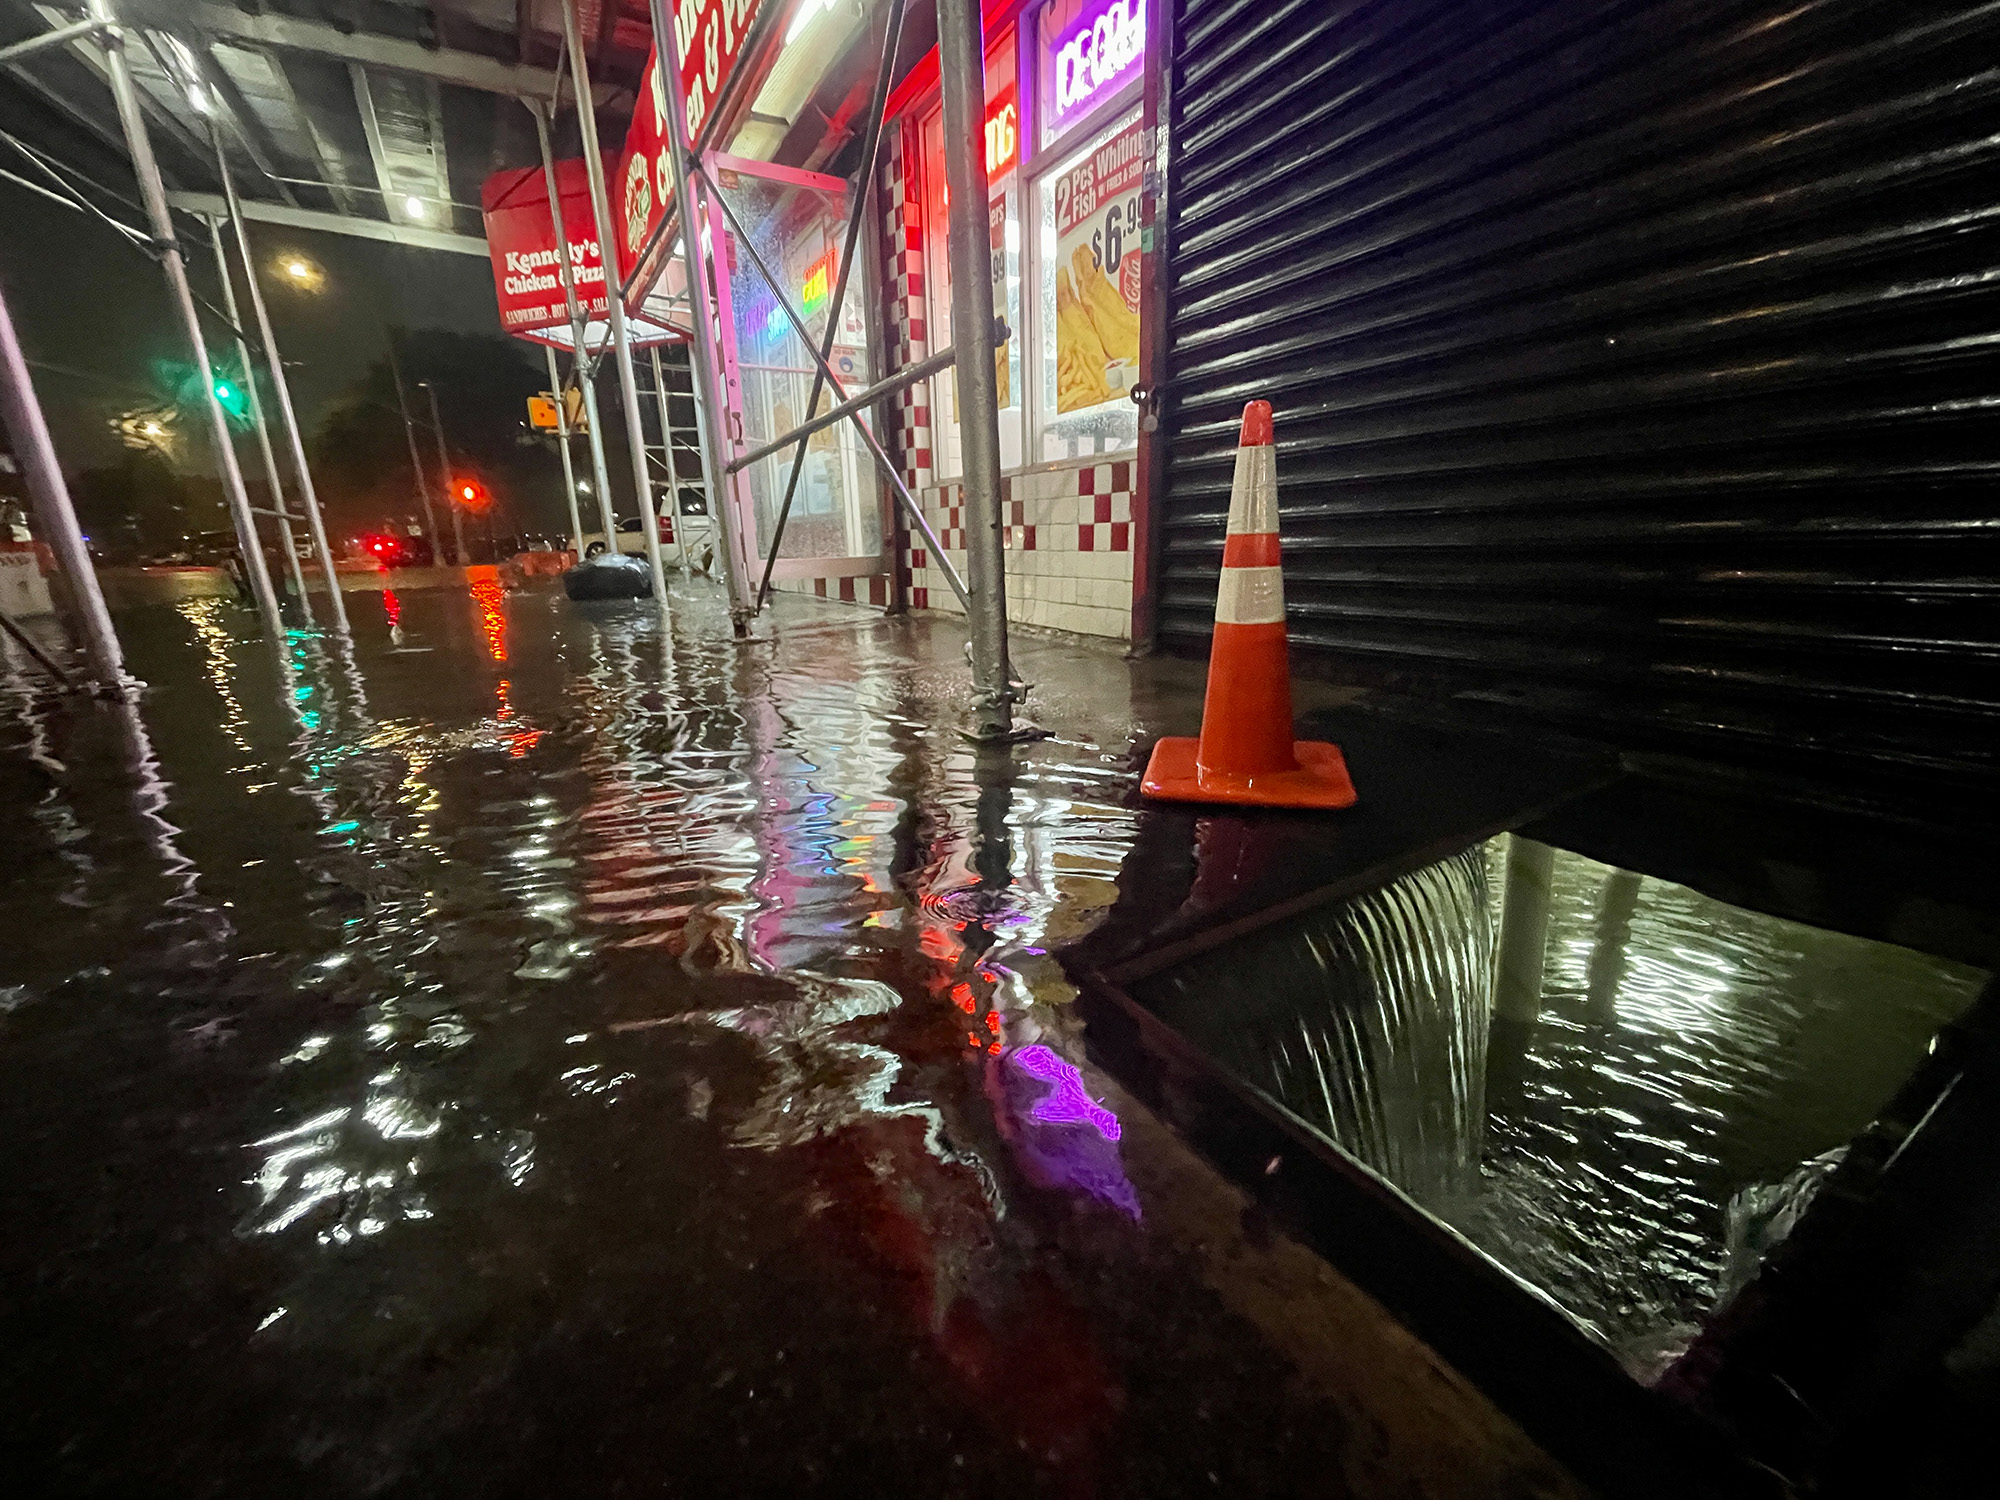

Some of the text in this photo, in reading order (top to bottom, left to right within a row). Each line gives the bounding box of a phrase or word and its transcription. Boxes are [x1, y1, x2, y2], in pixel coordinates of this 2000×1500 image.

[1057, 177, 1071, 231] 2
[1073, 163, 1094, 197] Pcs
[504, 273, 557, 295] Chicken
[506, 305, 548, 325] SANDWICHES
[551, 303, 566, 318] HOT
